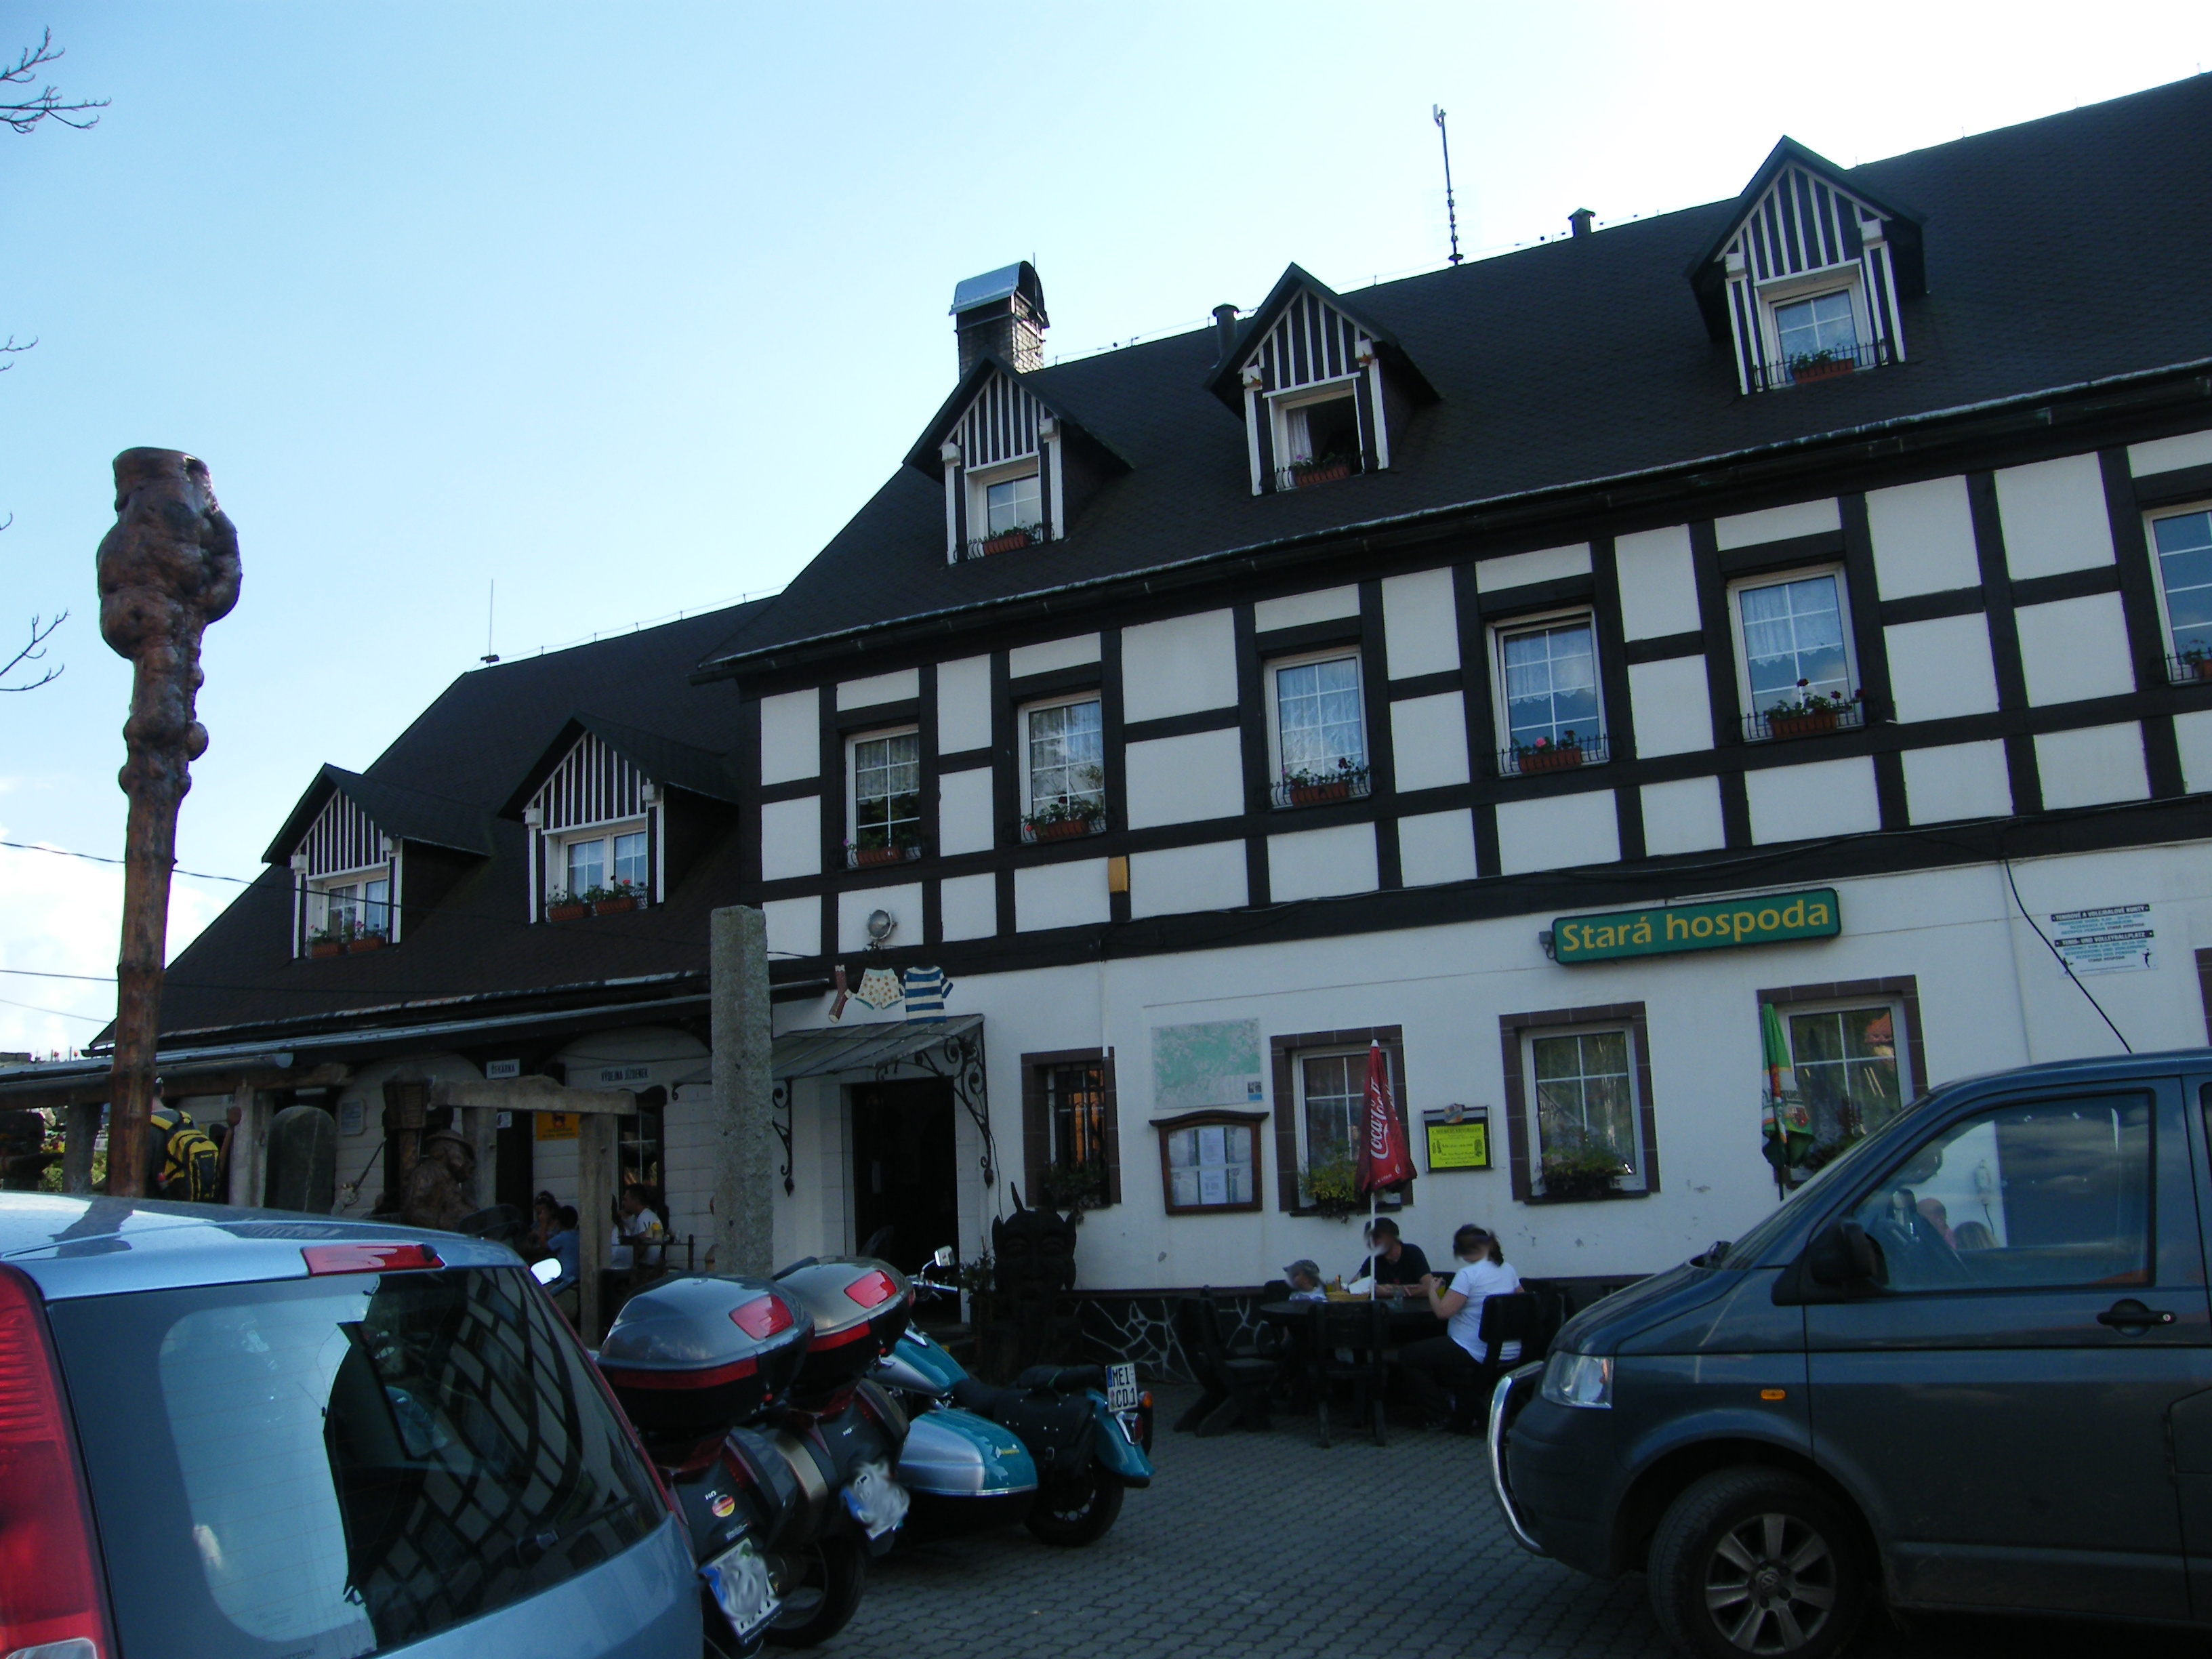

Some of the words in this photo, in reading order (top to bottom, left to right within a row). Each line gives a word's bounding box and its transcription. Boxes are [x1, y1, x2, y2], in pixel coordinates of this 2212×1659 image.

[1562, 916, 1652, 952] Stará
[1666, 899, 1829, 943] hospoda
[600, 1070, 623, 1082] VÝDEJNA
[625, 1067, 649, 1080] JÍZDENEK
[1112, 1367, 1130, 1387] MEI
